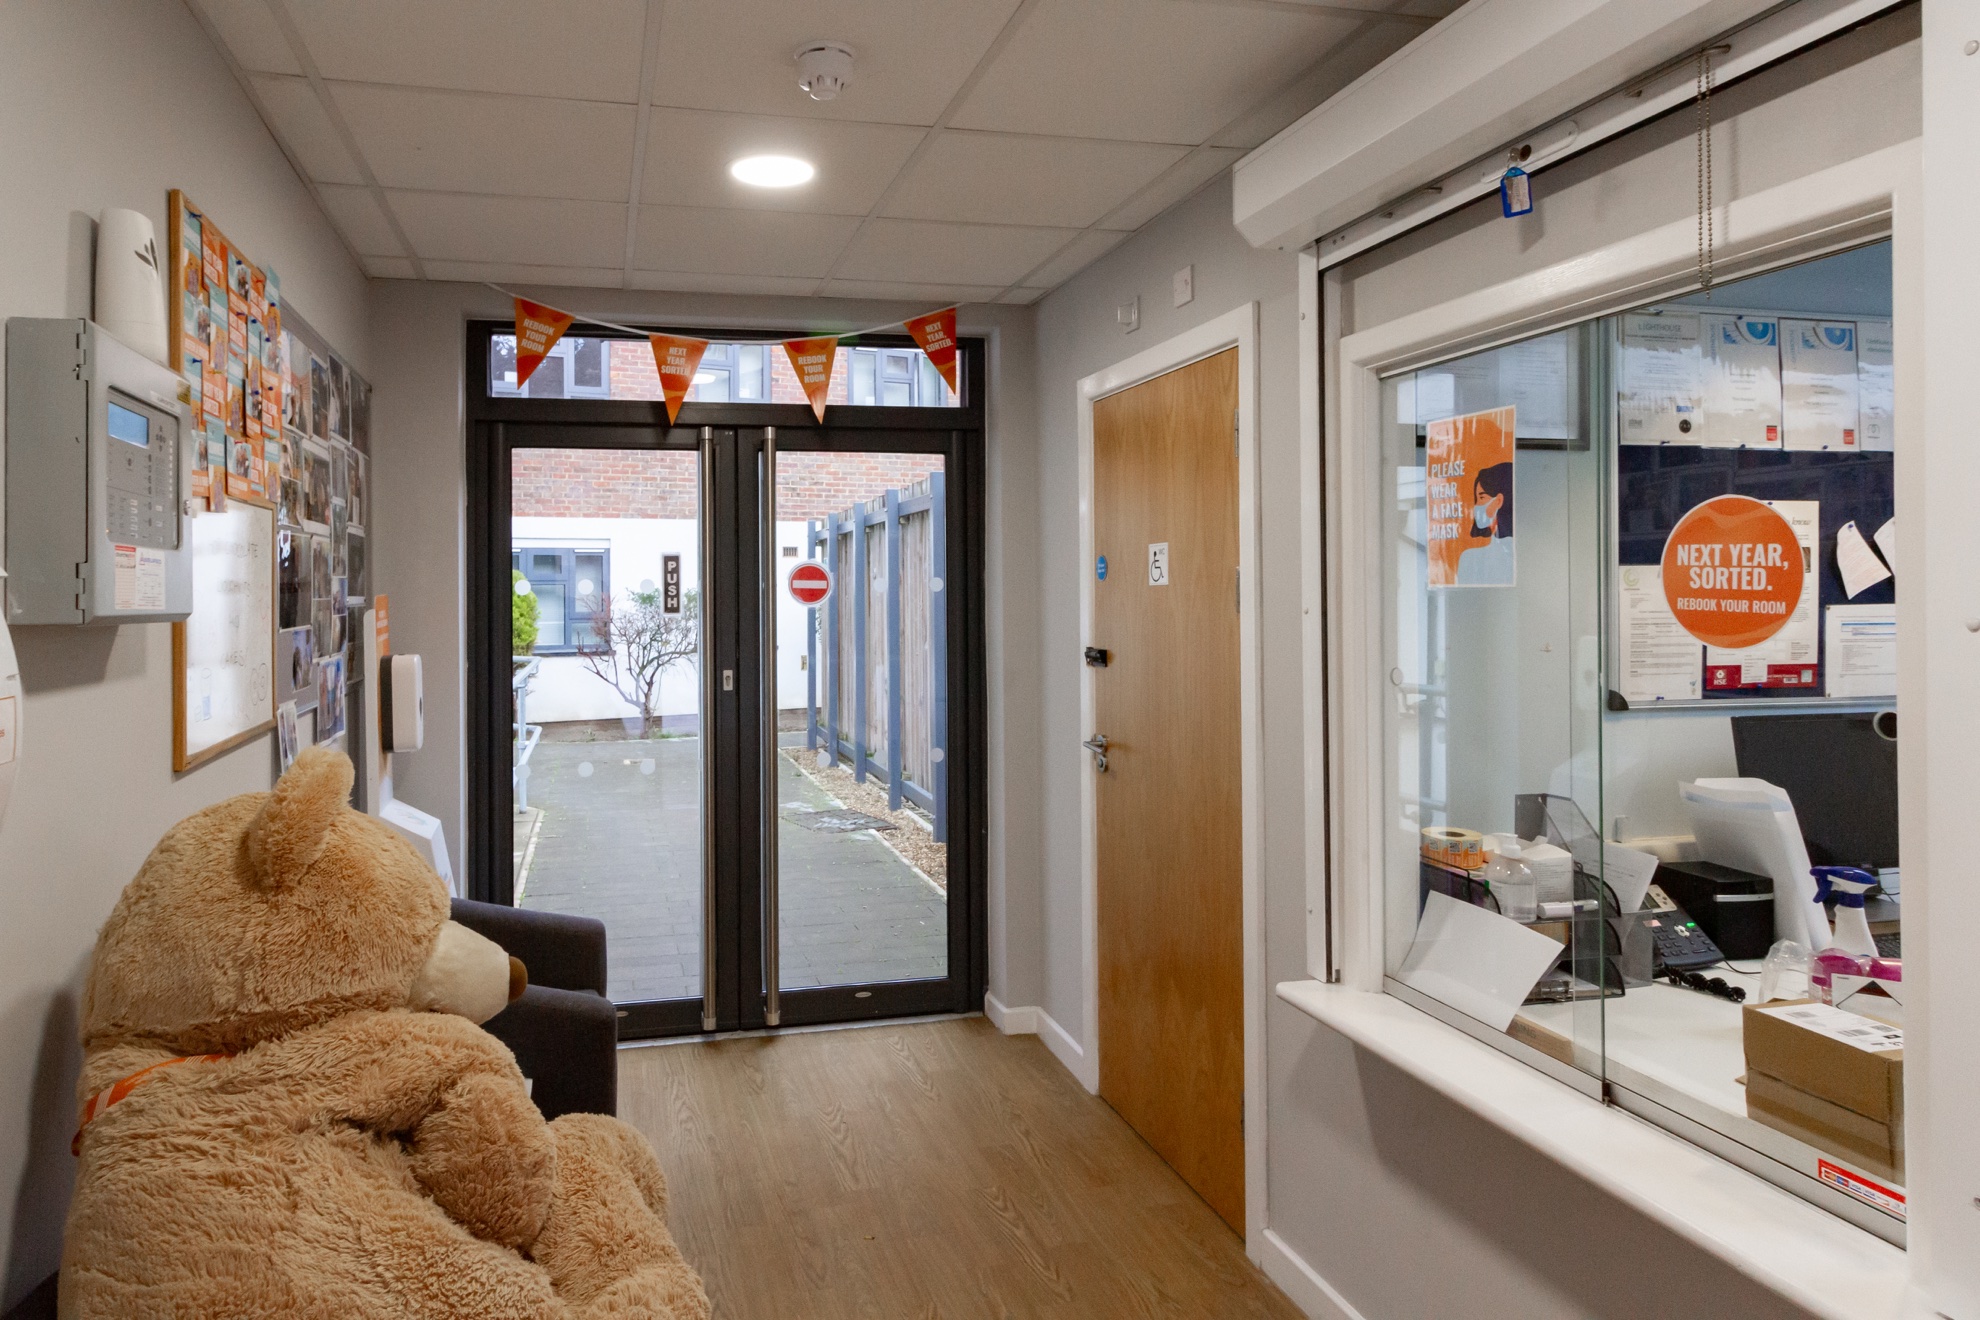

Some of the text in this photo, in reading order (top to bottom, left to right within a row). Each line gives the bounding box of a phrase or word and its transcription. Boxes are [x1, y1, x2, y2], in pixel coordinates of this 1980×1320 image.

[523, 318, 556, 337] REBOOK
[925, 321, 942, 334] NEXT
[525, 329, 547, 344] YOUR
[521, 338, 545, 354] ROOM
[669, 347, 688, 356] NEXT
[926, 339, 954, 353] SORTED.
[797, 354, 827, 365] REBOOK
[803, 365, 824, 375] YOUR
[804, 374, 826, 384] ROOM
[1431, 460, 1465, 478] PLEASE
[1431, 482, 1457, 499] WEAR
[1432, 501, 1463, 518] A FACE
[1431, 523, 1459, 540] MASK
[1676, 543, 1790, 571] NEXT YEAR,
[667, 561, 678, 608] PUSH
[1689, 567, 1774, 591] SORTED.
[1676, 597, 1787, 615] REBOOK YOUR ROOM
